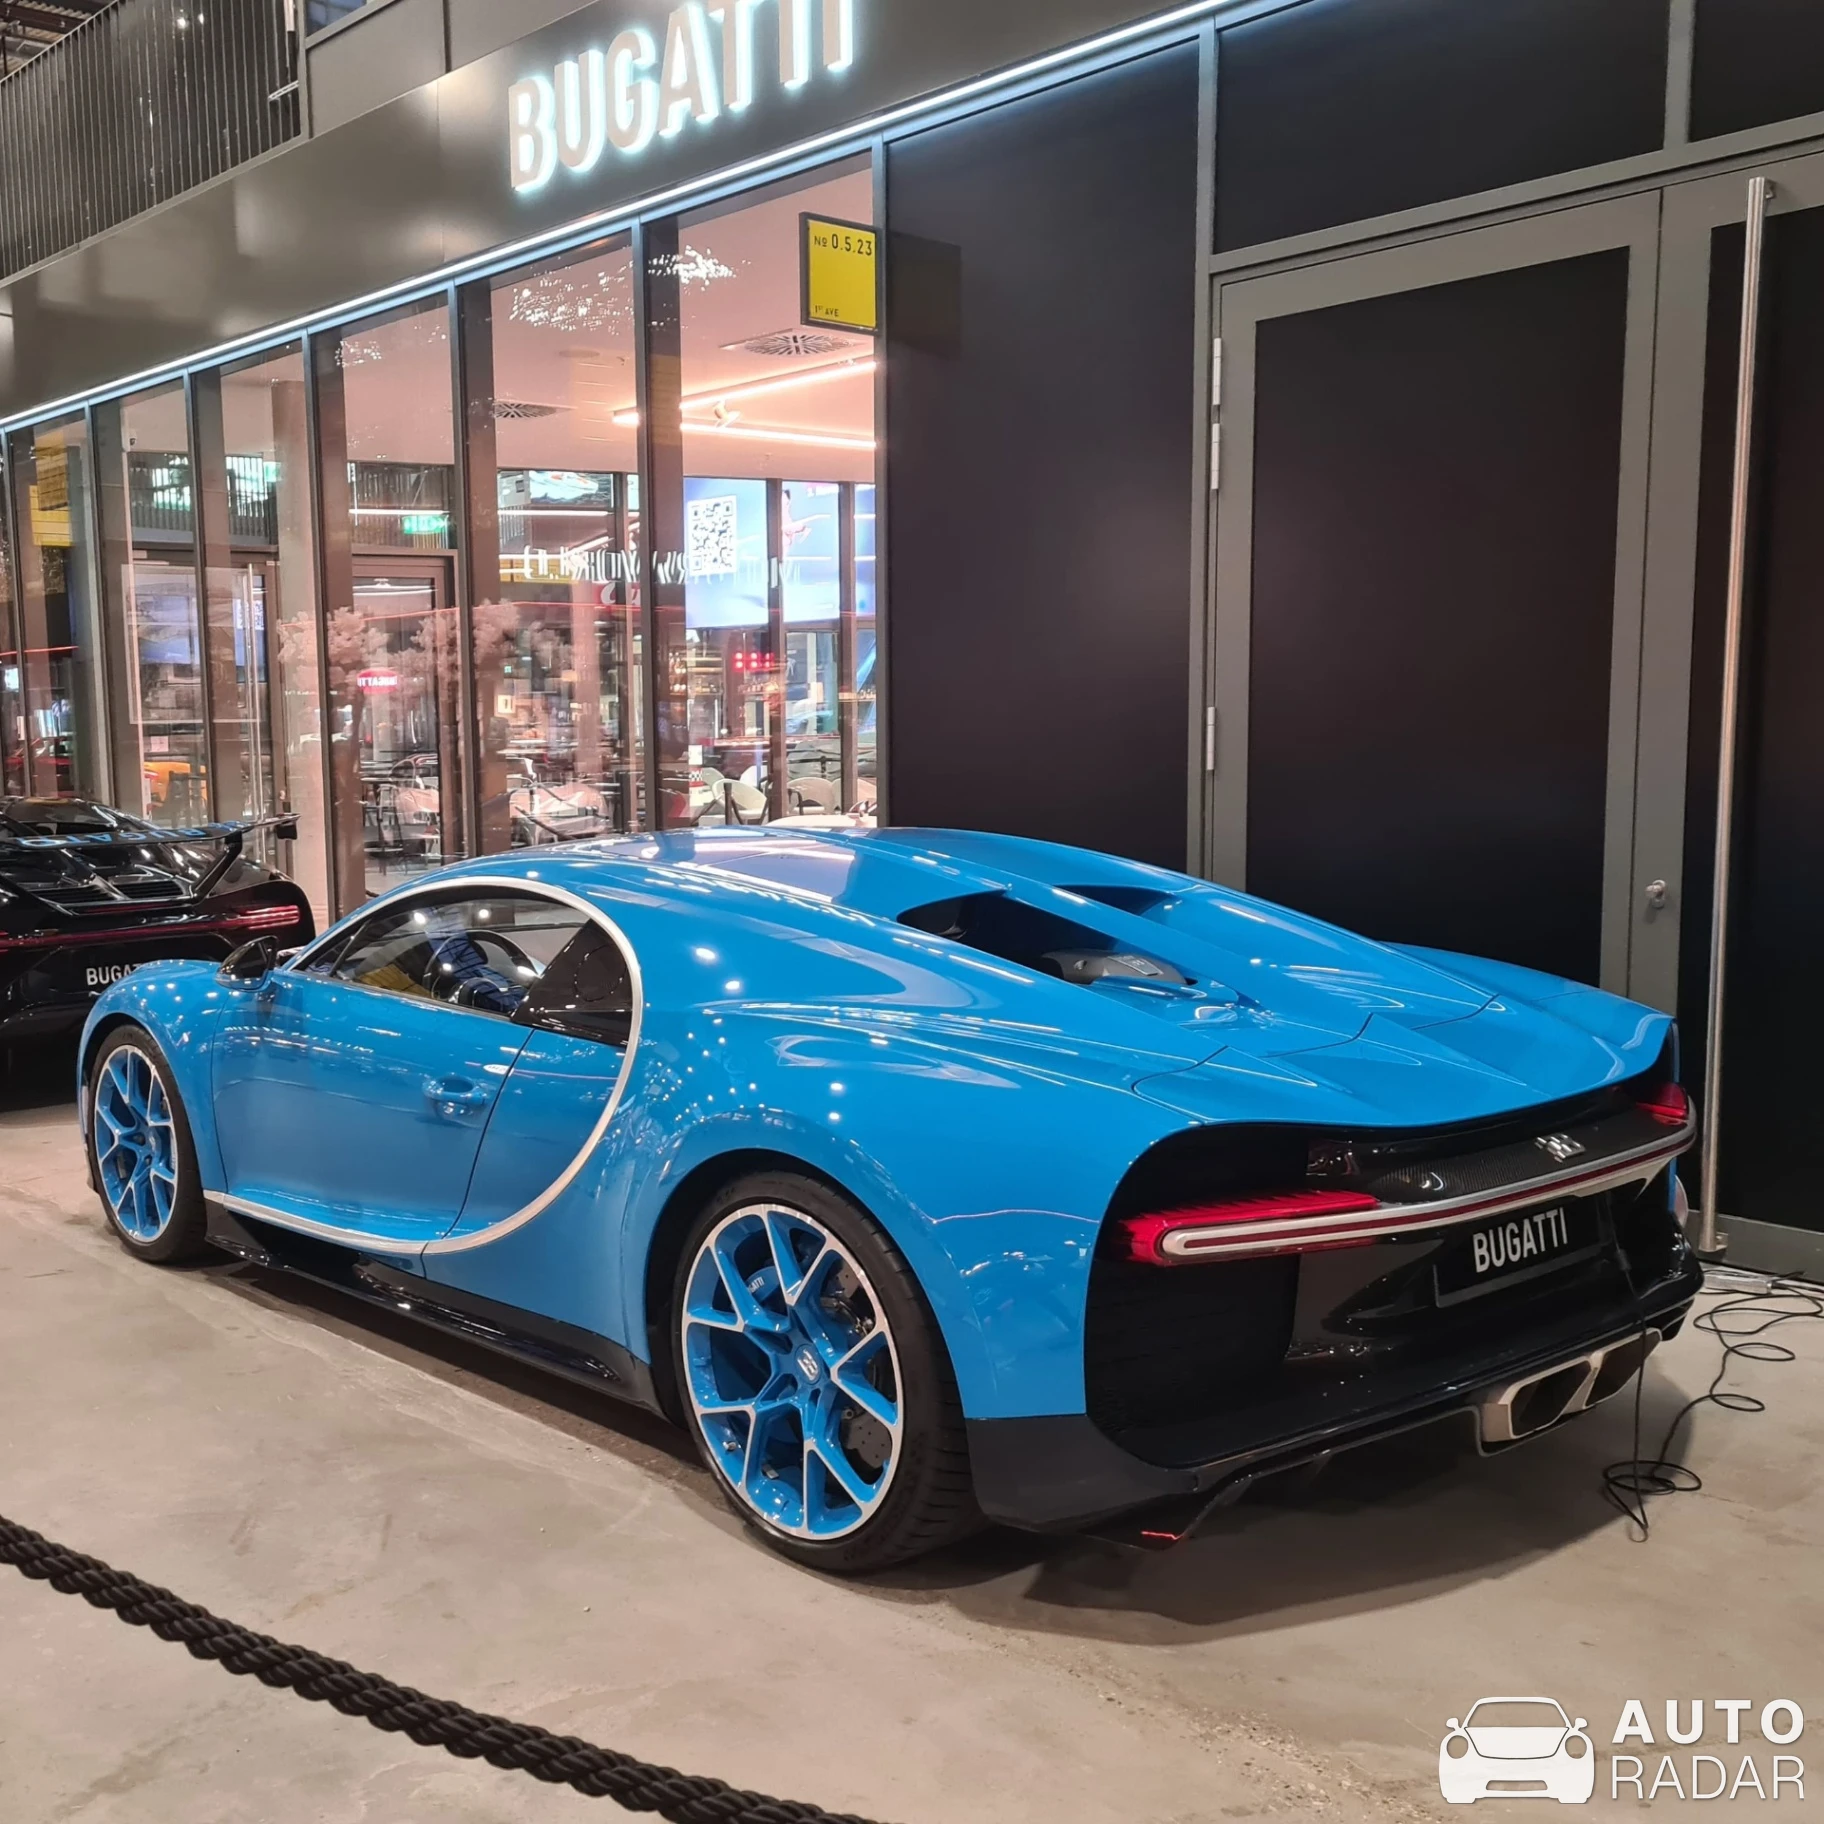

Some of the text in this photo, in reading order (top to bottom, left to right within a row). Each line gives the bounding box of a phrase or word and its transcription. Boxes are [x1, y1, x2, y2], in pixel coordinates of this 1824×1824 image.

[508, 0, 855, 193] BUGATTI
[831, 233, 872, 256] 0.5.23
[825, 307, 840, 318] AVE
[86, 963, 143, 986] BUGA
[1472, 1207, 1568, 1273] BUGATTI
